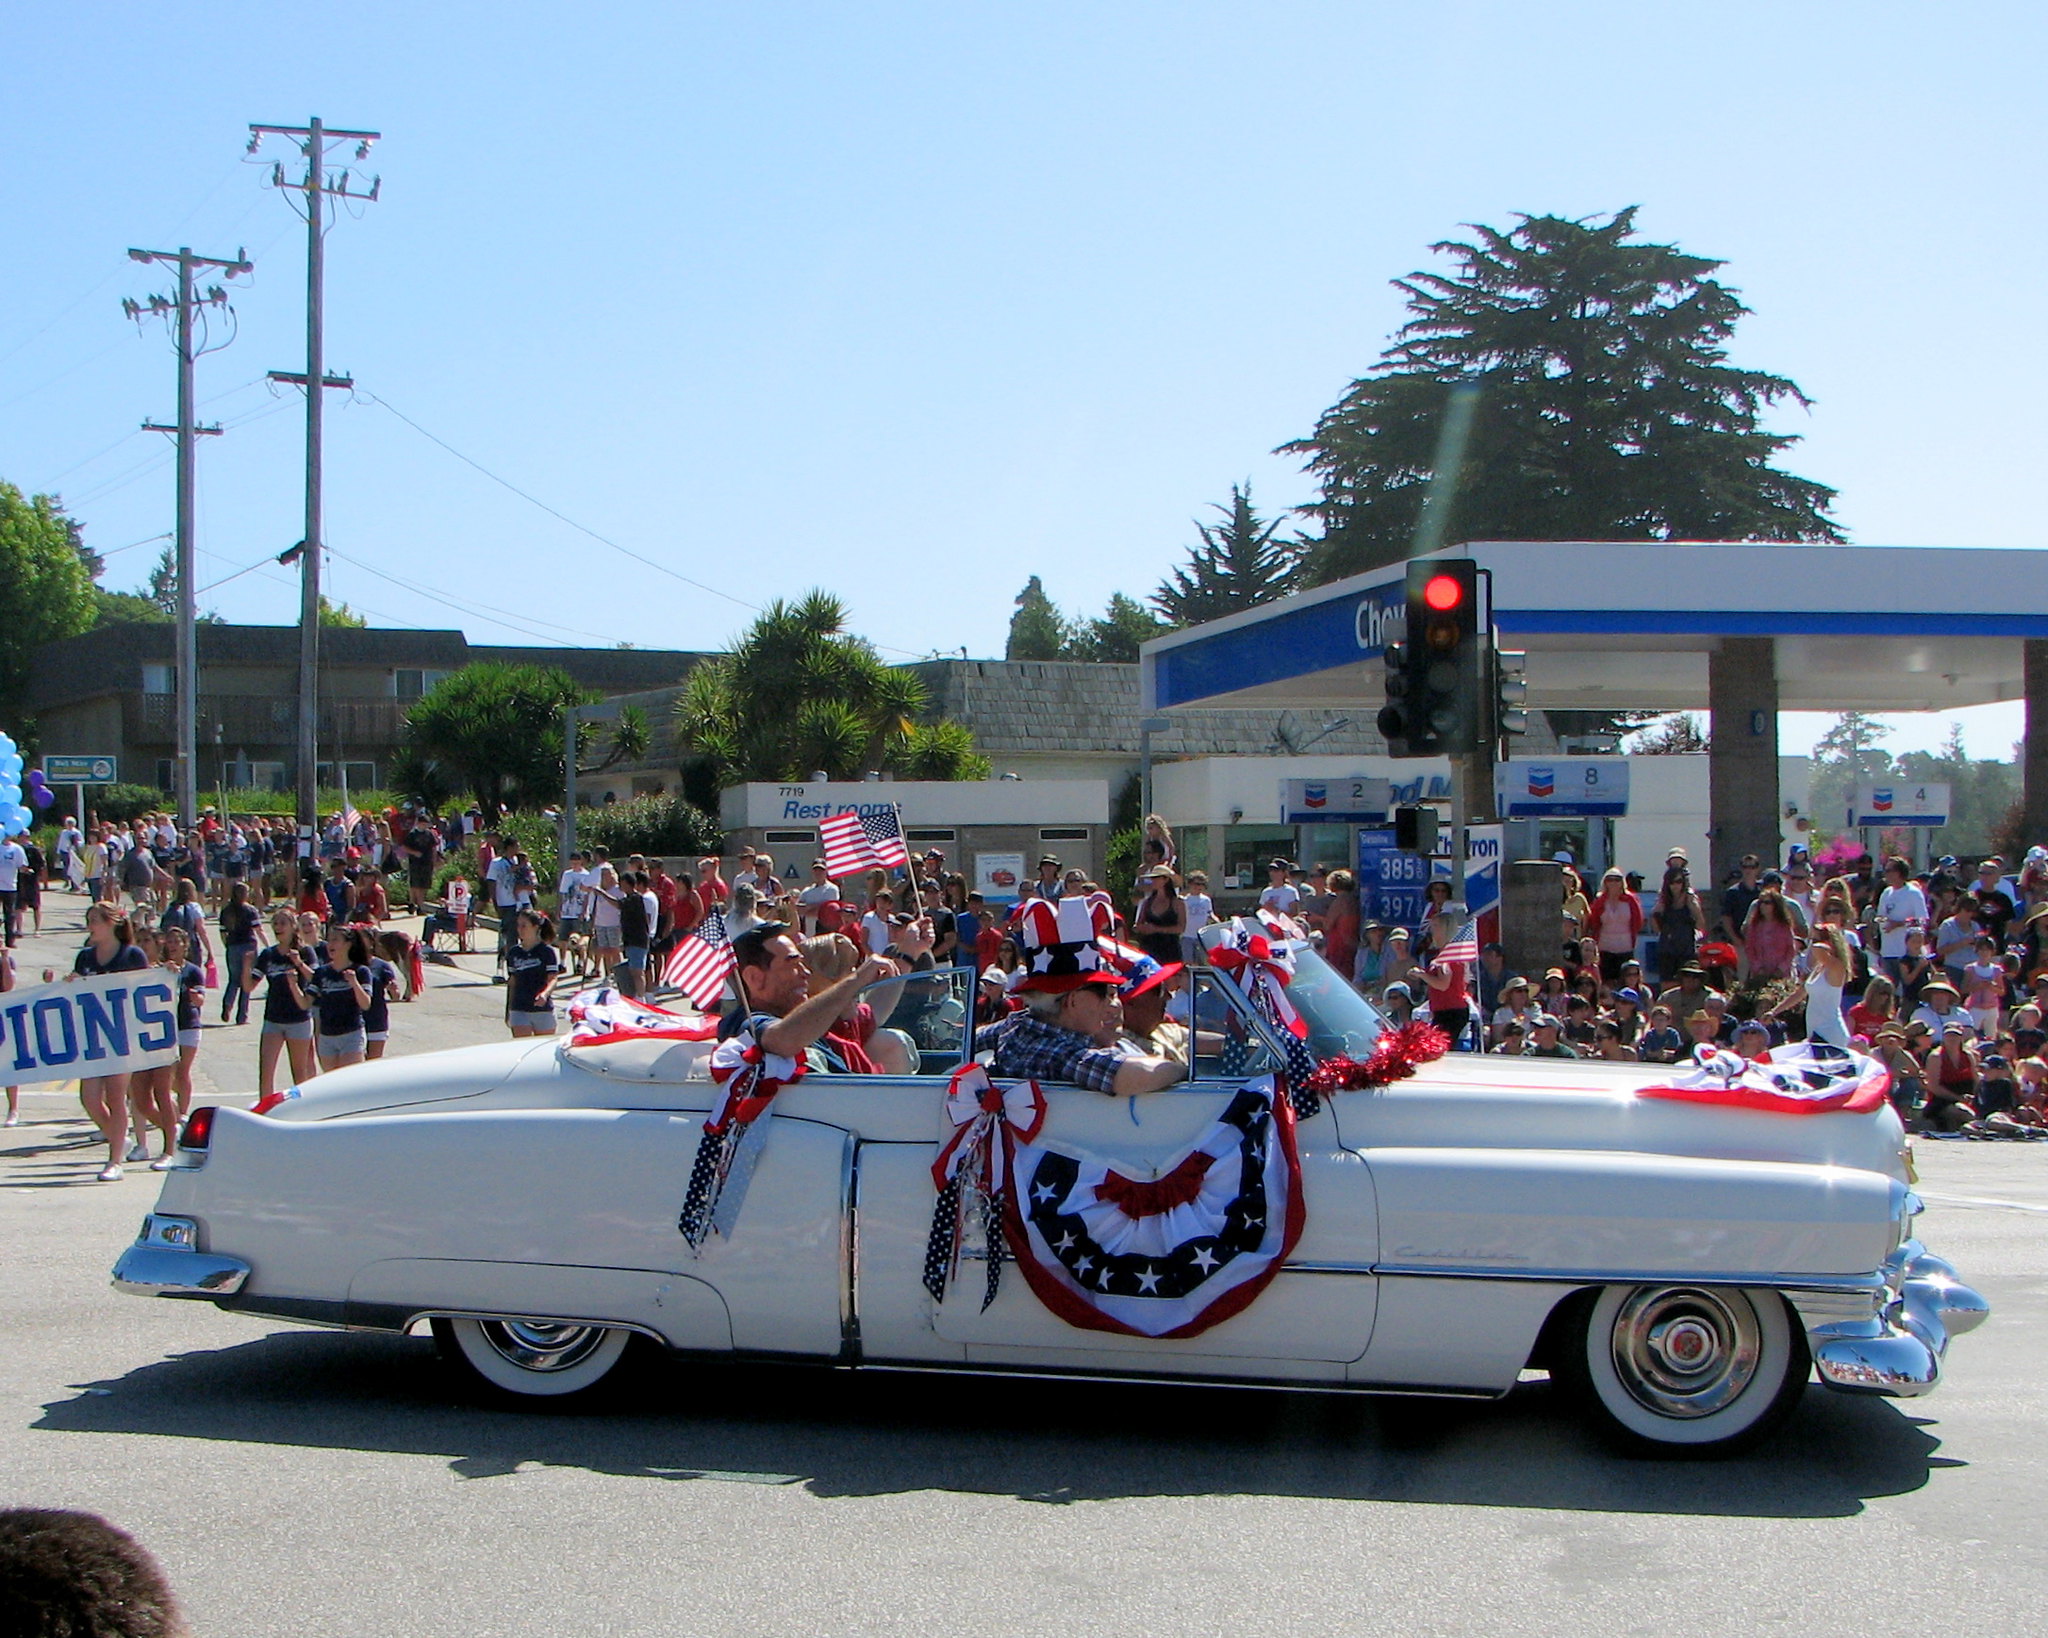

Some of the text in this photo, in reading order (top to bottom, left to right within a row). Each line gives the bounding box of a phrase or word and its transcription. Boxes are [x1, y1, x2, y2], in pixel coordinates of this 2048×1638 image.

[1584, 767, 1598, 785] 8
[779, 787, 804, 797] 7719
[1352, 783, 1363, 798] 2
[1915, 787, 1926, 801] 4
[783, 800, 831, 819] Rest
[1380, 858, 1415, 880] 385
[1380, 895, 1414, 918] 397
[0, 983, 178, 1070] IONS
